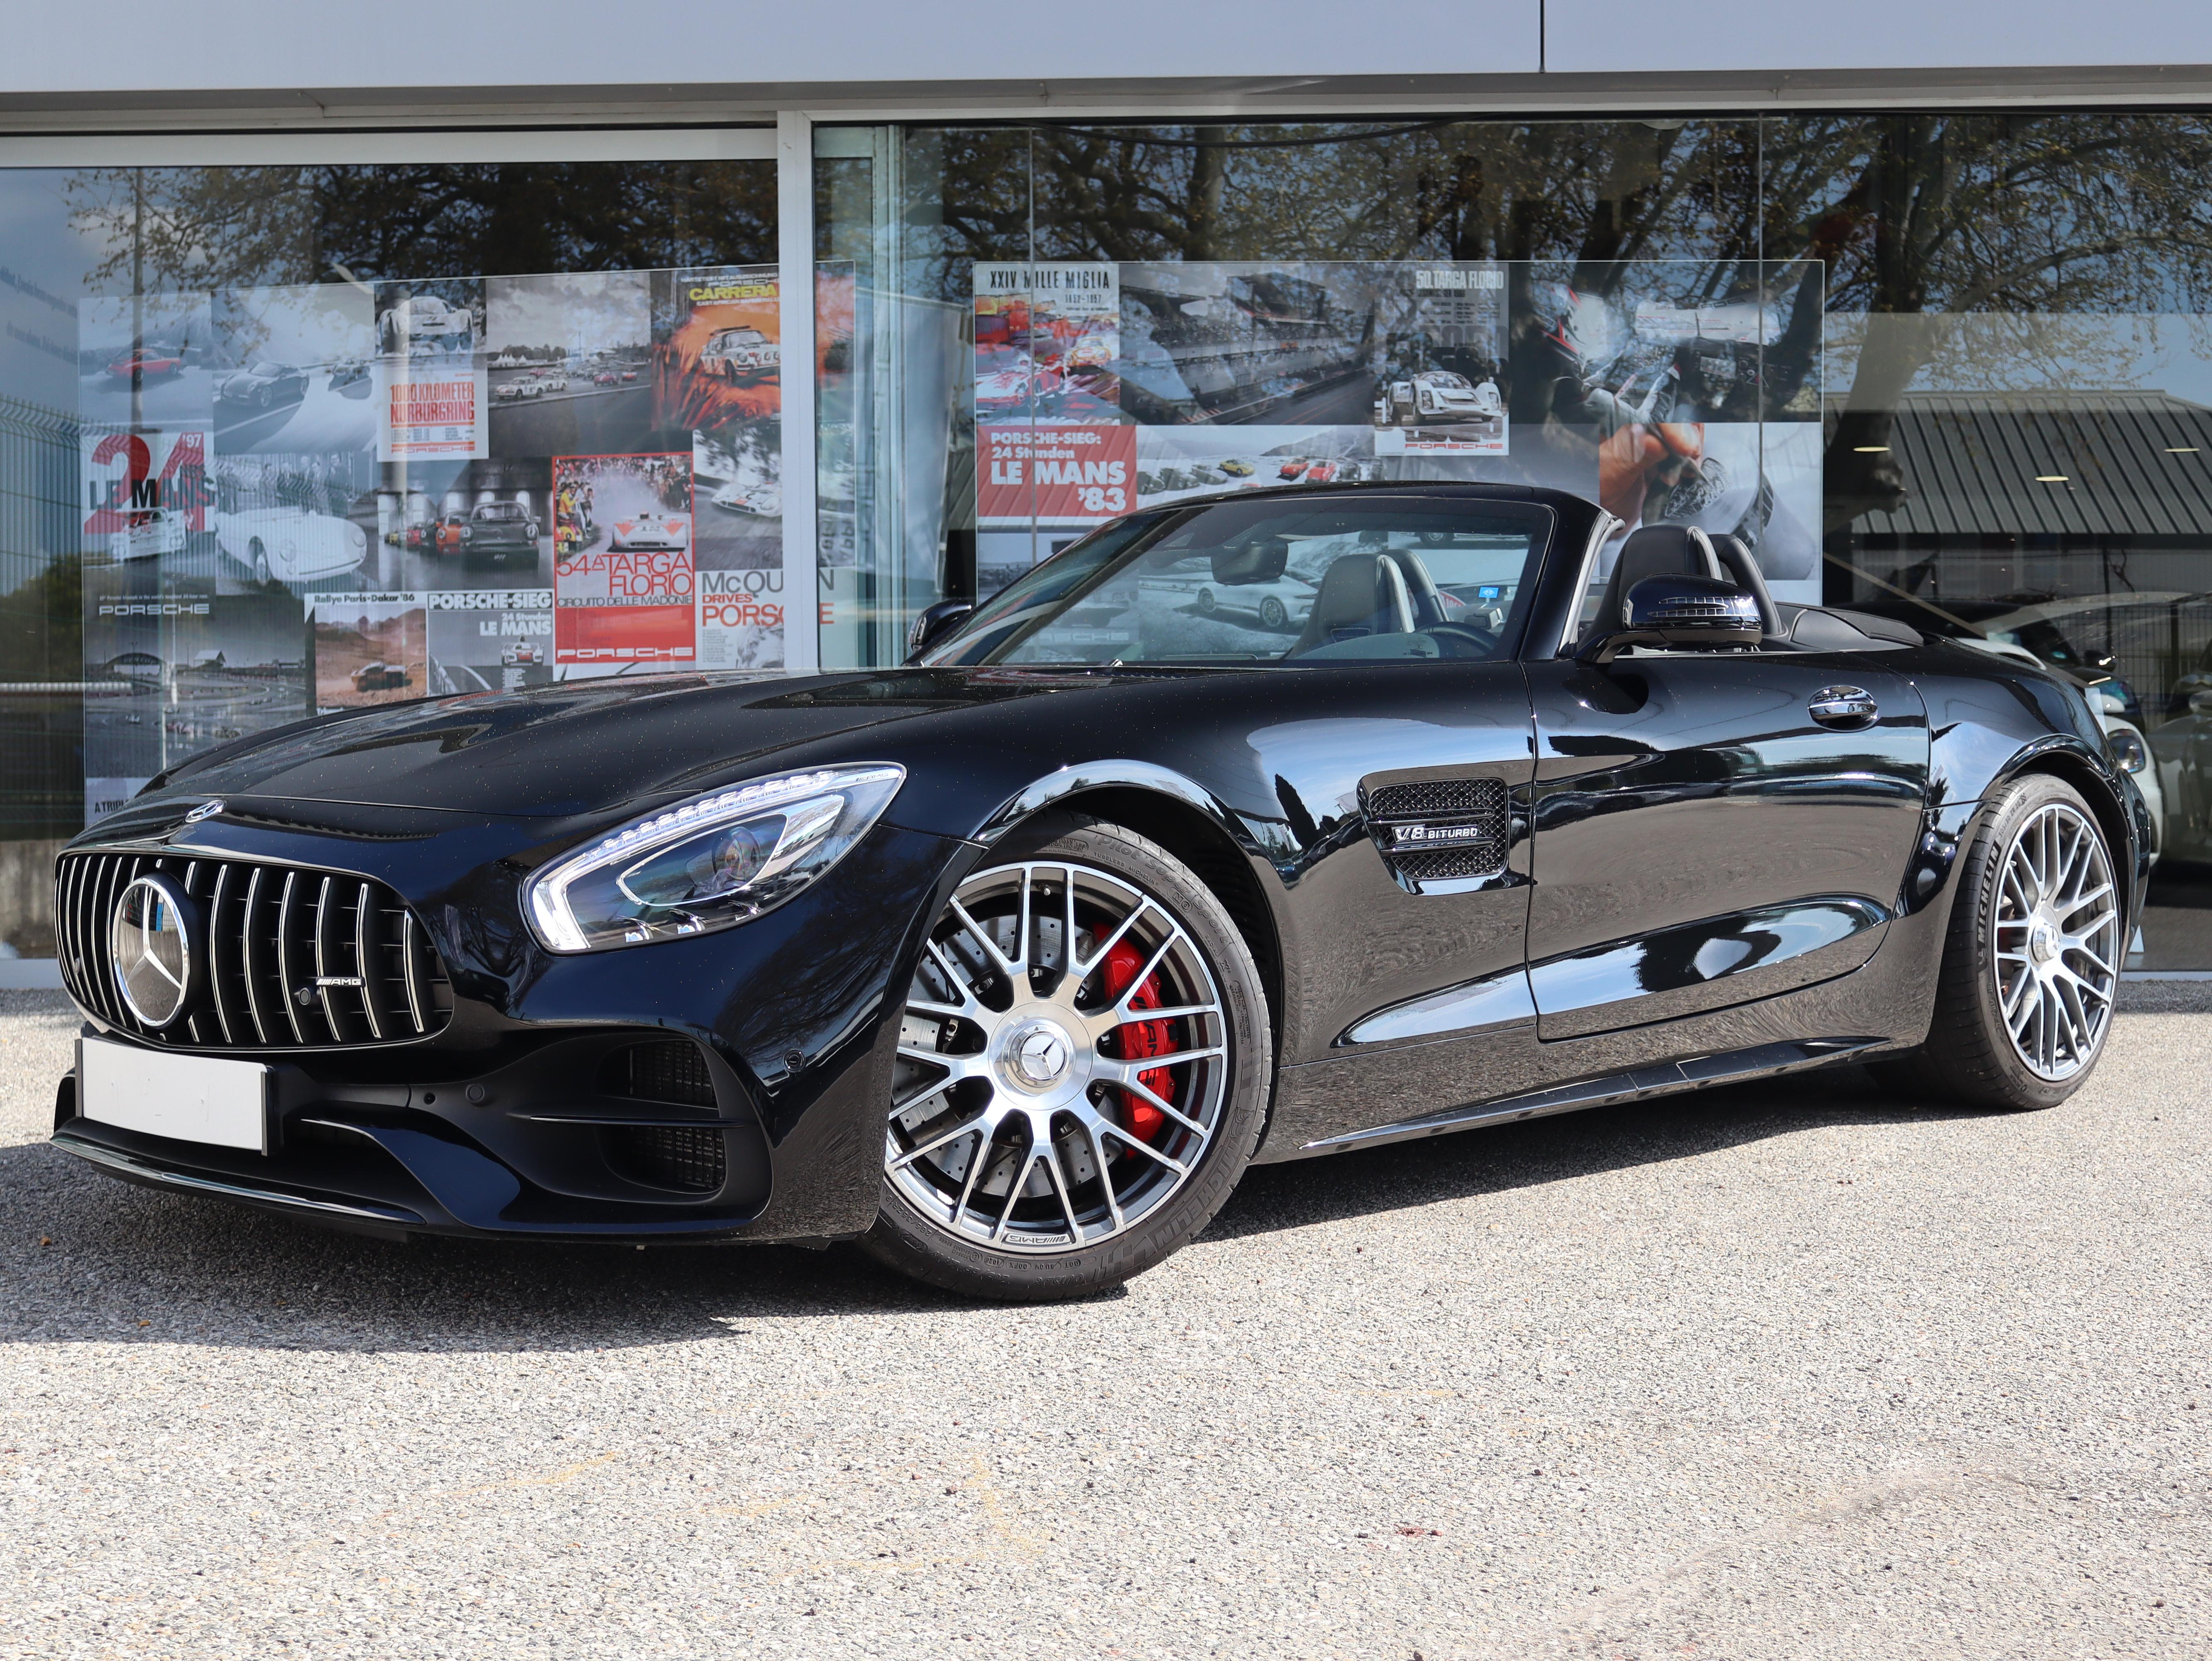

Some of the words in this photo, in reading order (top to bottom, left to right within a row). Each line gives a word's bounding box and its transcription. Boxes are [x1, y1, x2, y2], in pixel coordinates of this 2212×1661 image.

[708, 278, 779, 287] PORSCH
[991, 271, 1016, 288] XXIV
[1024, 271, 1058, 288] MILLE
[1066, 271, 1109, 288] MIGLIA
[690, 284, 778, 301] CARRERA
[391, 383, 416, 402] 1000
[419, 381, 475, 401] KILOMETER
[183, 434, 202, 448] '97
[991, 432, 1101, 444] PORSCHE-SIEG:
[992, 447, 1013, 459] 24
[1015, 446, 1074, 459] Stunden
[991, 462, 1023, 485] LE
[1036, 461, 1127, 485] MANS
[84, 432, 204, 535] 24
[90, 480, 123, 510] LE
[132, 479, 216, 511] MANS
[1078, 488, 1127, 512] '83
[602, 552, 692, 575] TARGA
[609, 573, 692, 596] FLORIO
[702, 569, 834, 598] McQUN
[314, 595, 342, 605] Rallye
[344, 593, 399, 602] Paris-Dakar
[429, 592, 552, 610] PORSCHE-SIEG
[558, 597, 605, 608] CIRCUITO
[607, 596, 639, 606] DELLE
[641, 595, 692, 605] MADONIE
[702, 593, 753, 604] DRIVES
[99, 603, 209, 616] PORSCHE
[501, 612, 514, 621] 24
[516, 612, 552, 621] Stunden
[702, 603, 834, 627] PORSE
[480, 621, 497, 636] LE
[501, 620, 552, 636] MANS
[558, 647, 693, 658] PORSCHE
[1395, 827, 1424, 840] V8
[1428, 828, 1478, 839] BITURBO
[1094, 851, 1126, 867] TUBELESS
[1129, 865, 1157, 886] MICHELIN
[1098, 836, 1141, 860] Pilot
[1145, 859, 1190, 893] Super
[1193, 899, 1230, 943] Sport
[1978, 846, 2000, 943] MICHELIN
[1155, 1142, 1242, 1246] MICHELIN
[1009, 1235, 1045, 1245] AMG
[1034, 1273, 1084, 1286] OUTSIDE
